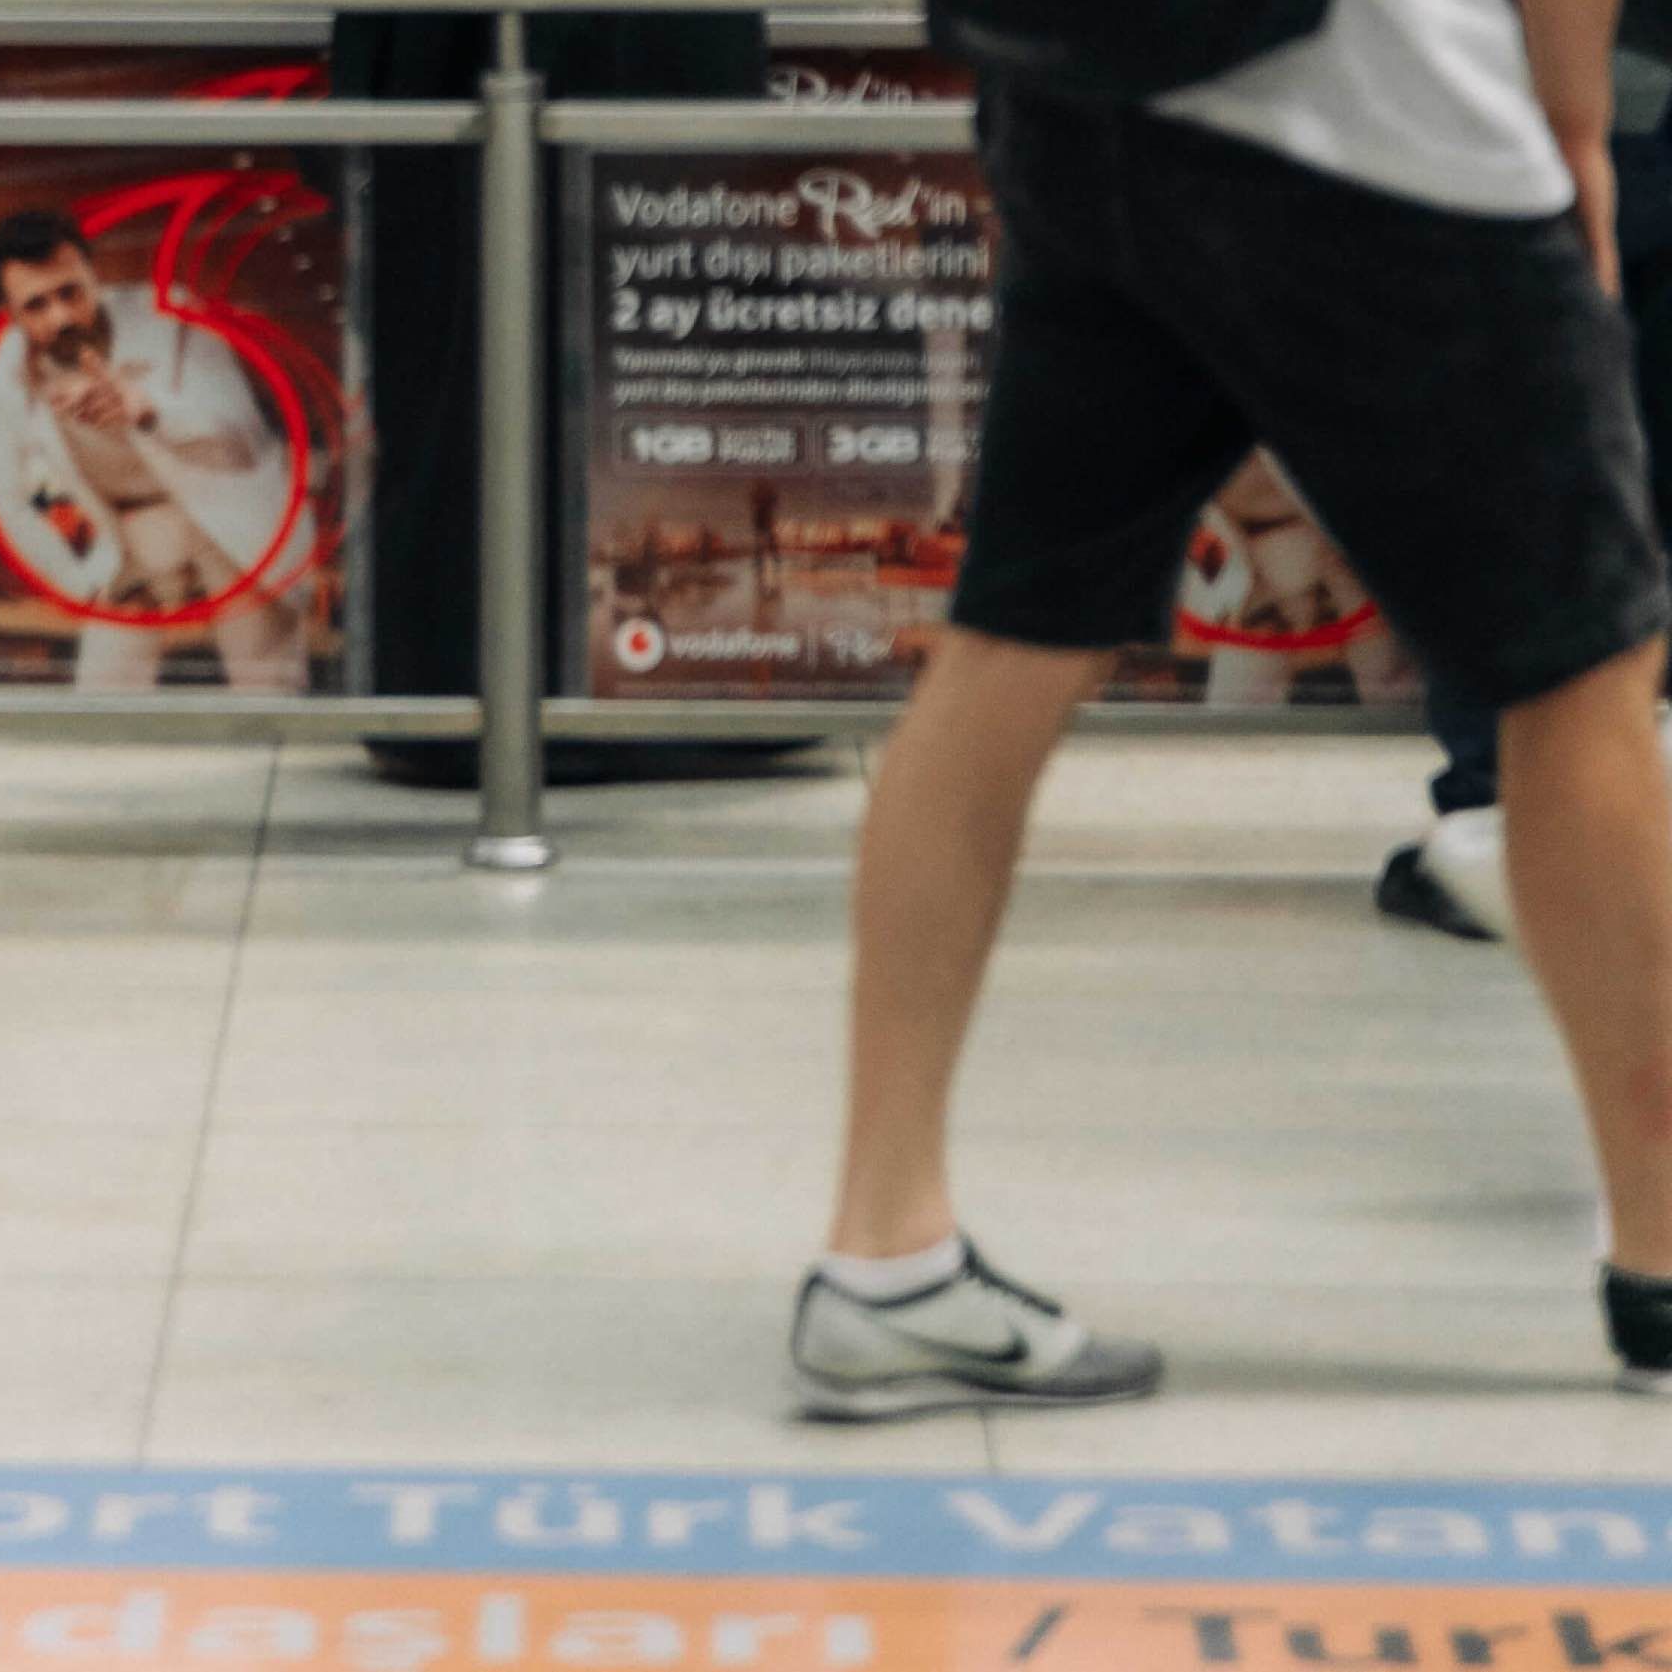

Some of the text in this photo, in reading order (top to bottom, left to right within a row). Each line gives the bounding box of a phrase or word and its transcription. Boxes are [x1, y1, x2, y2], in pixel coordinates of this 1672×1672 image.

[611, 181, 799, 229] Vodafone
[610, 288, 643, 333] 2
[884, 287, 995, 333] dene
[348, 1480, 872, 1551] Türk
[942, 1487, 1672, 1559] Vatan
